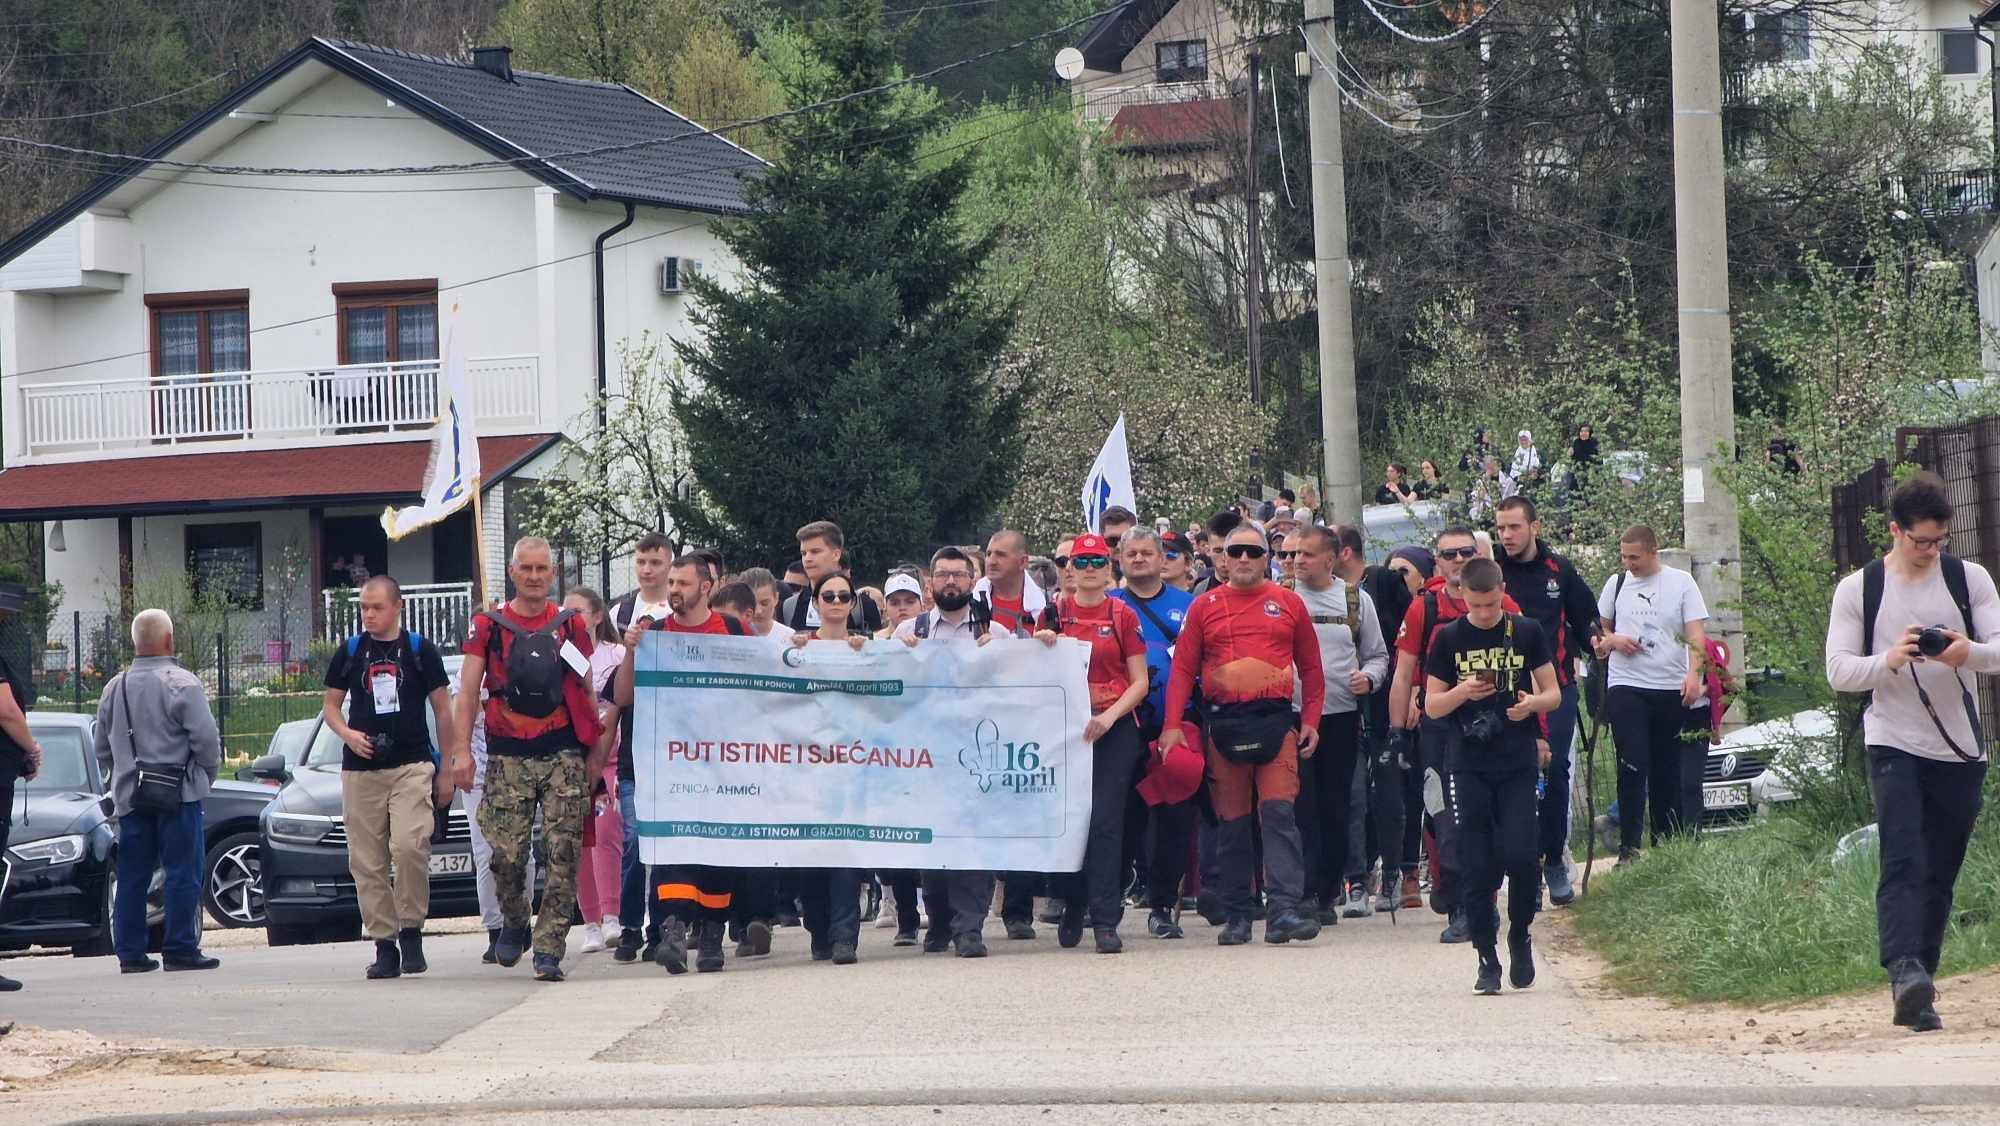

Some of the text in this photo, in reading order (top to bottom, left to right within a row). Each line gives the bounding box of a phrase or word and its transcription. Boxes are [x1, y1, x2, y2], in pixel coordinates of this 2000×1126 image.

[1455, 646, 1525, 672] LEVEL
[696, 676, 707, 684] NE
[708, 677, 748, 687] ZABORAVI
[765, 680, 795, 689] PONOVI
[668, 740, 934, 768] PUT ISTINE I SJEĆANJA
[1003, 742, 1040, 771] 16
[1002, 766, 1056, 793] april
[672, 824, 727, 836] TRAGAMO
[731, 826, 745, 837] ZA
[750, 827, 800, 837] ISTINOM
[810, 826, 865, 838] GRADIMO
[869, 827, 920, 841] SUŽIVOT
[429, 855, 468, 872] -137
